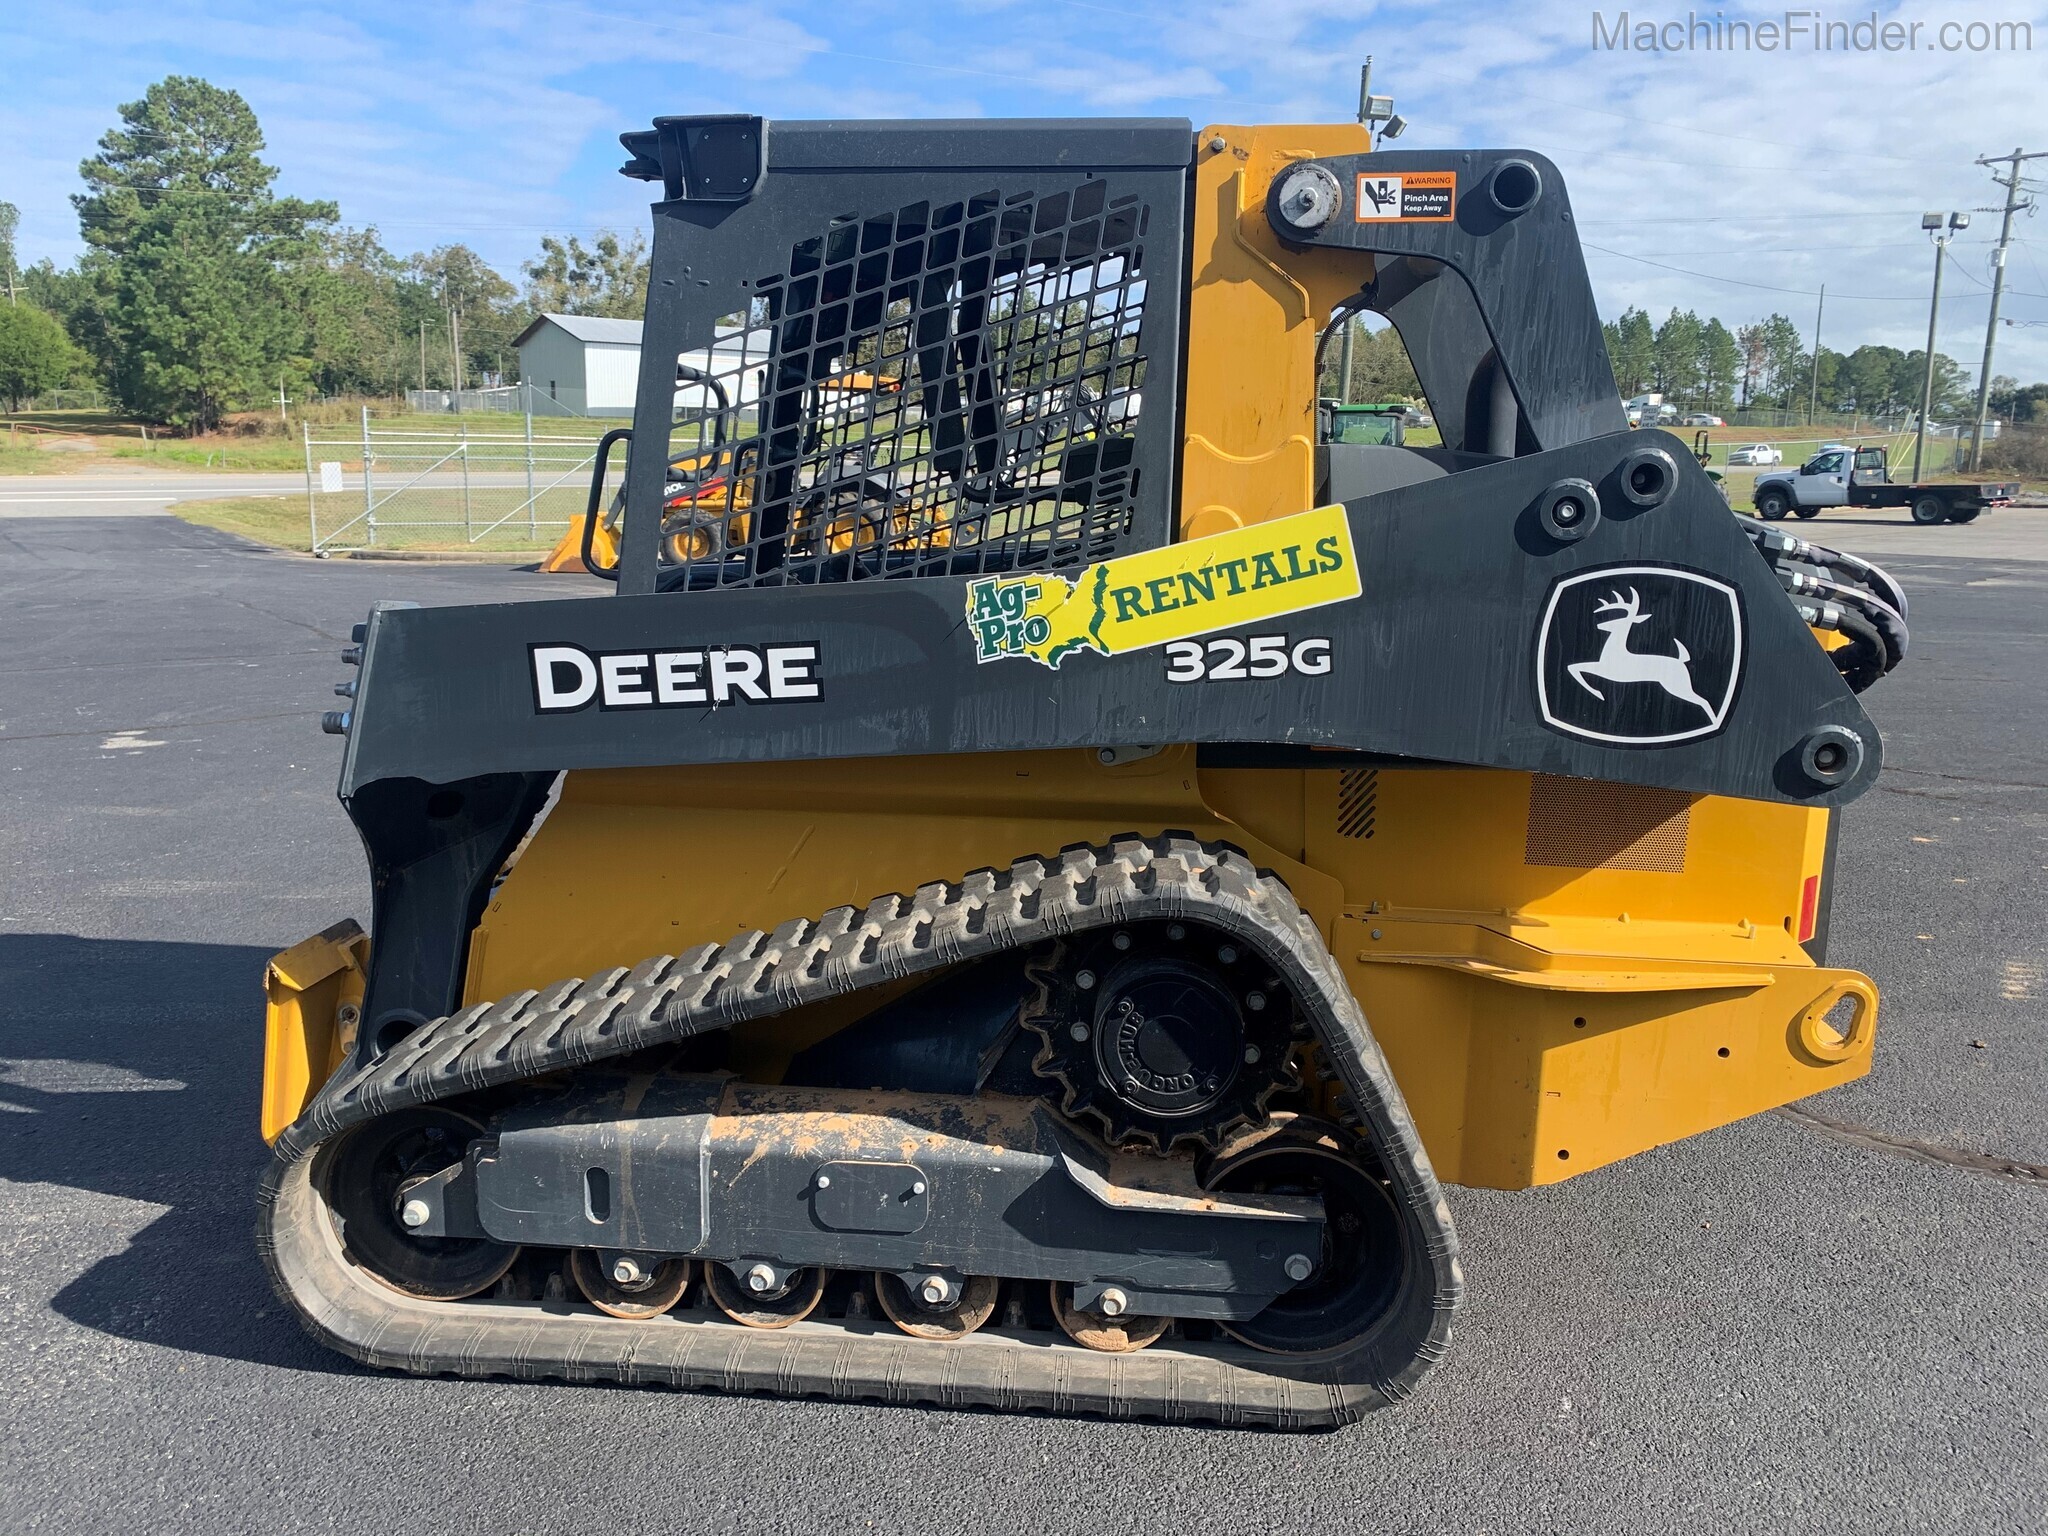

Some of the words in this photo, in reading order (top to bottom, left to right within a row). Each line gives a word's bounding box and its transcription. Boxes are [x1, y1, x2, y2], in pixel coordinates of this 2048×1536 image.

[1404, 194, 1428, 202] Pinch
[1428, 194, 1449, 202] Area
[1404, 205, 1422, 213] Keep
[1423, 204, 1442, 212] Away
[971, 578, 1043, 620] Ag-
[1110, 536, 1344, 623] RENTALS
[976, 614, 1051, 661] Pro
[1165, 636, 1332, 682] 325G
[534, 646, 819, 709] DEERE
